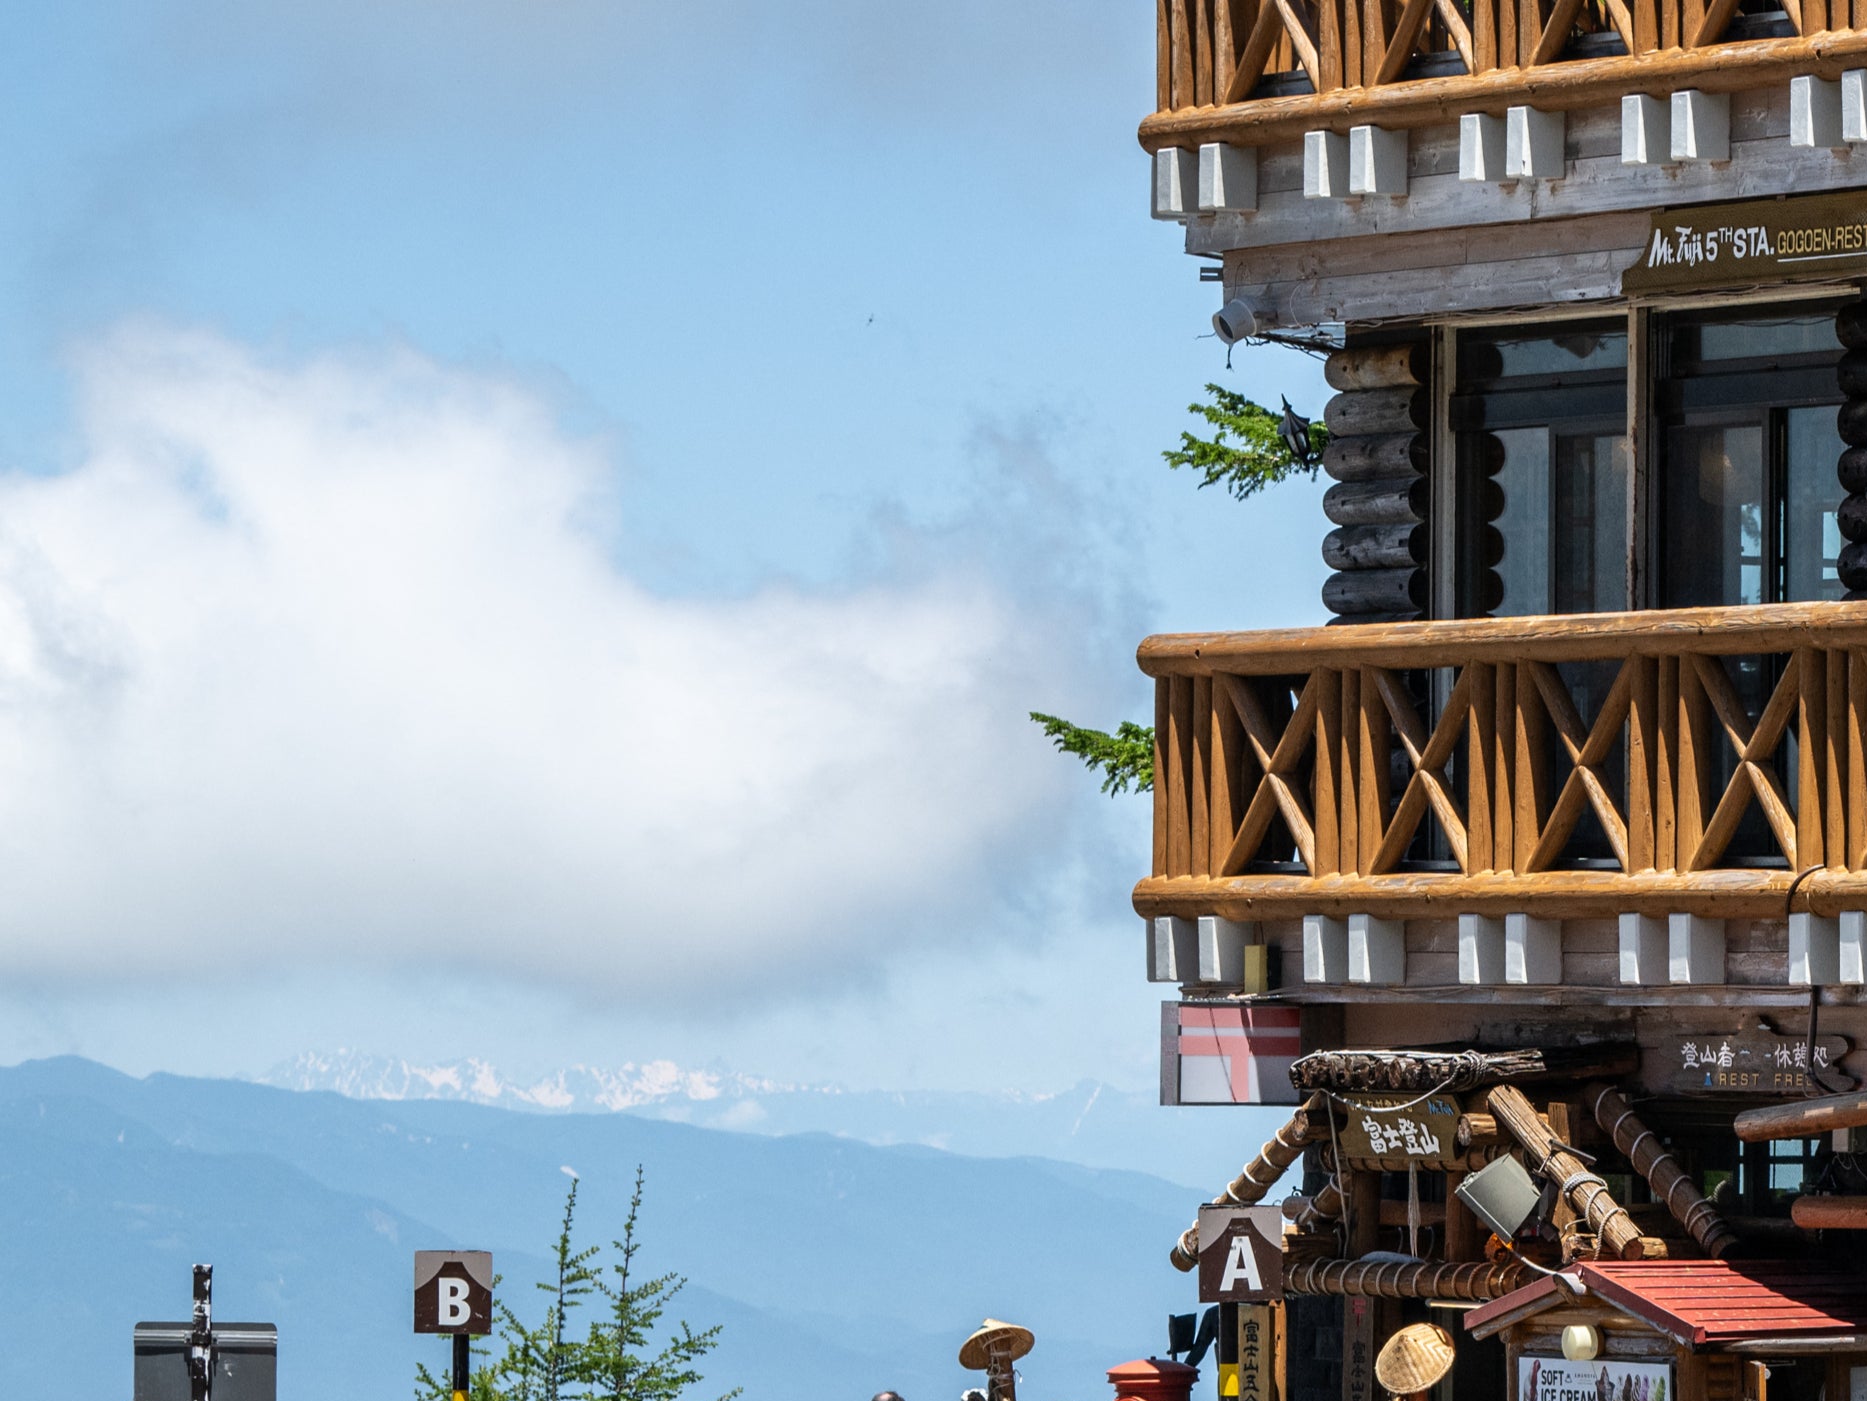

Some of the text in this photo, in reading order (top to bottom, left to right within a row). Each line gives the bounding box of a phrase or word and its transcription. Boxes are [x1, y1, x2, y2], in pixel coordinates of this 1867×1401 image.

[1648, 228, 1675, 267] Mt.
[1675, 226, 1703, 267] Fuji
[1733, 226, 1775, 259] STA.
[1681, 1041, 1736, 1070] 登山者
[1719, 1072, 1760, 1087] REST
[1362, 1115, 1440, 1155] 富士登山
[1220, 1235, 1262, 1292] A
[437, 1277, 470, 1326] B
[1541, 1369, 1564, 1386] SOFT
